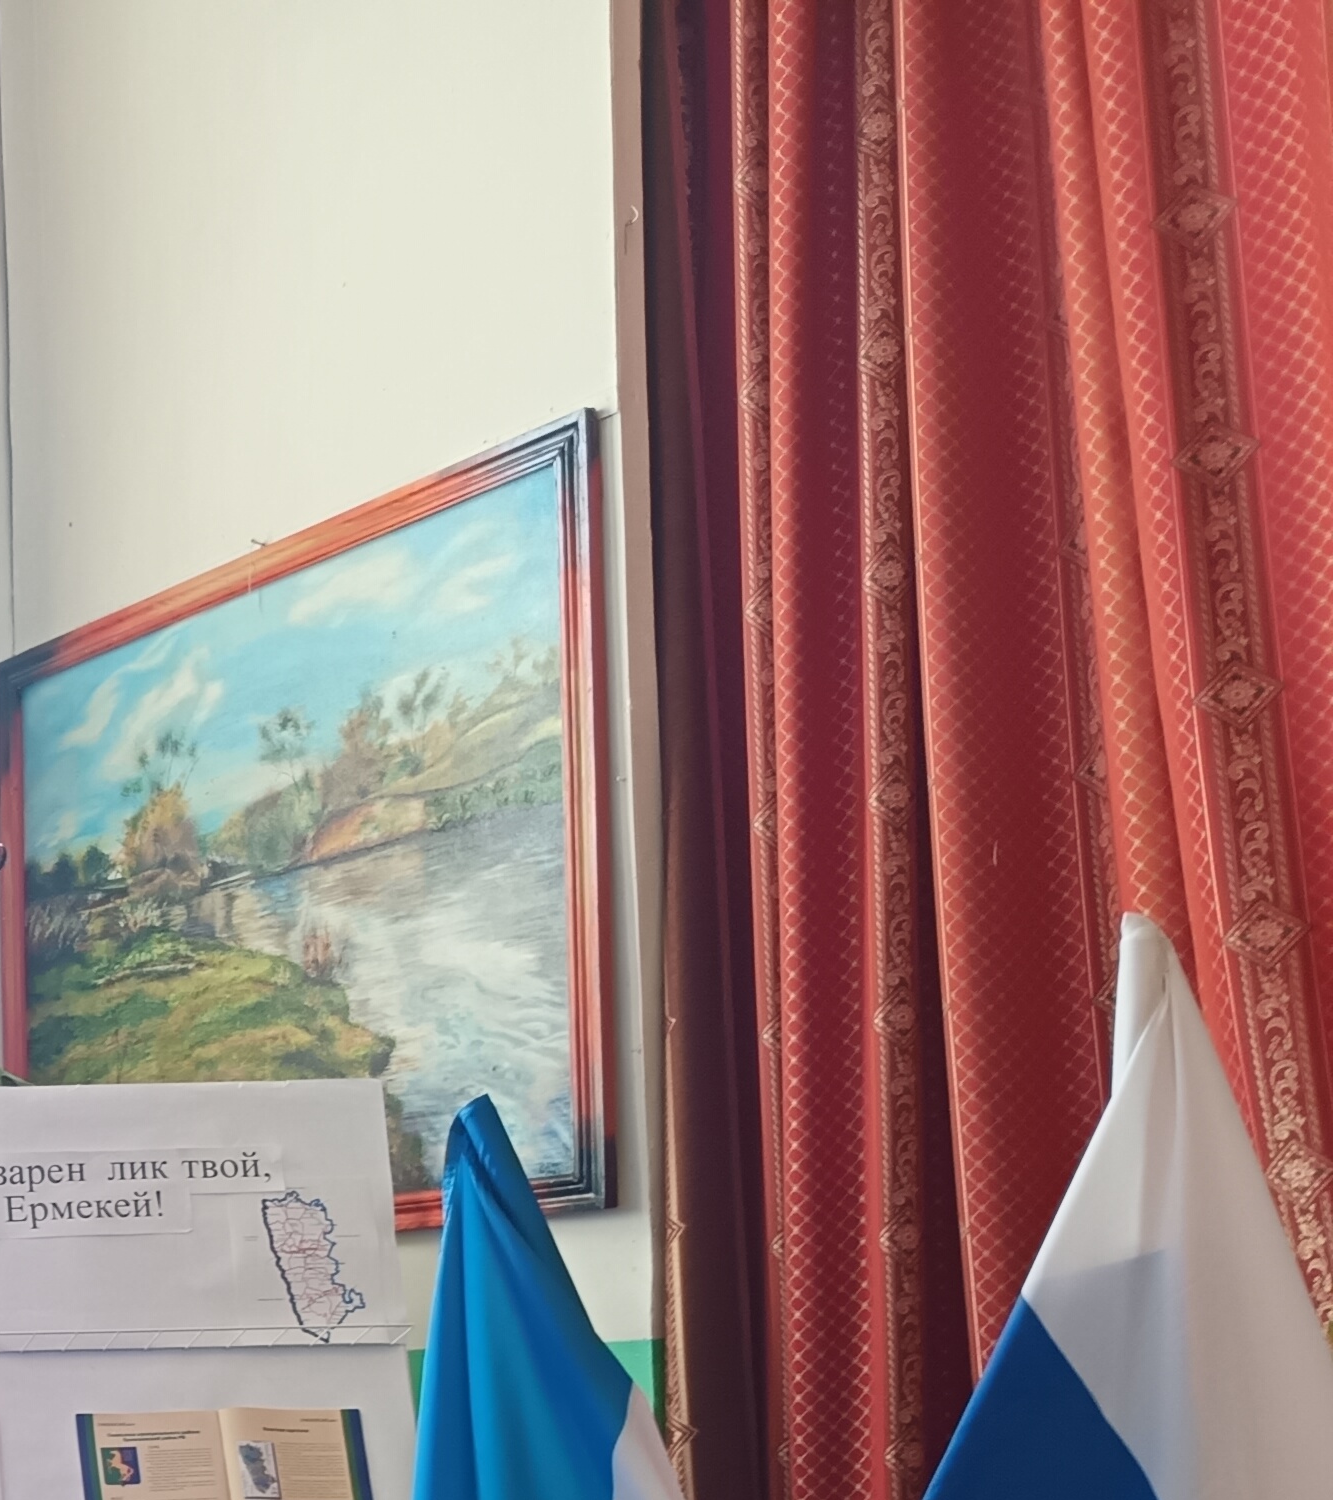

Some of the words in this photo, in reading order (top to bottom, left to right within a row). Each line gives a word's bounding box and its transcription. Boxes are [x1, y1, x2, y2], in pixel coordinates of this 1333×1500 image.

[107, 1159, 169, 1181] лик
[181, 1151, 272, 1183] твой,
[4, 1189, 164, 1229] Ермекей!
